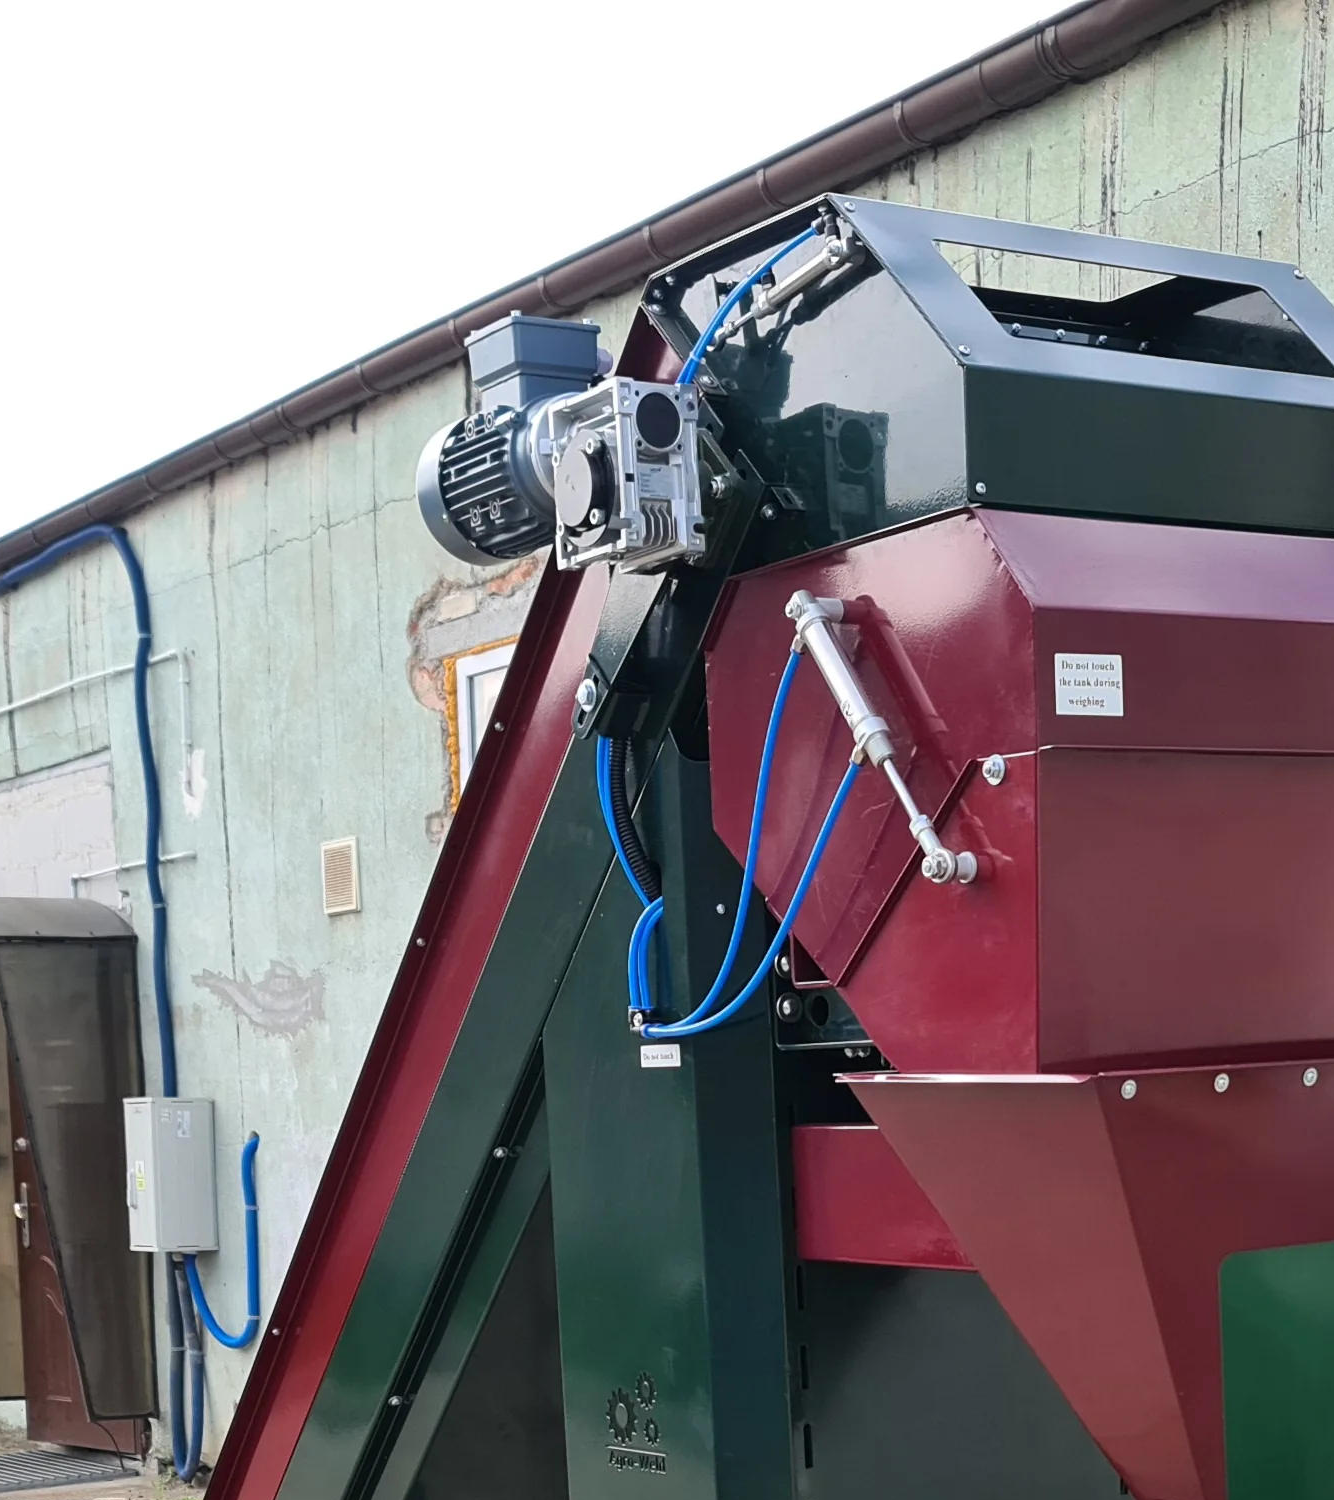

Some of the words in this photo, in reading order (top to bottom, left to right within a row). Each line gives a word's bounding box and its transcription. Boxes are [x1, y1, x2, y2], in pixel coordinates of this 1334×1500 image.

[1061, 660, 1073, 670] Do
[1075, 661, 1089, 670] not
[1091, 661, 1115, 671] touch
[1059, 677, 1072, 687] the
[1074, 677, 1092, 687] tank
[1093, 677, 1121, 690] during
[1068, 696, 1105, 708] weighing
[608, 1450, 666, 1474] Agro-Weld
